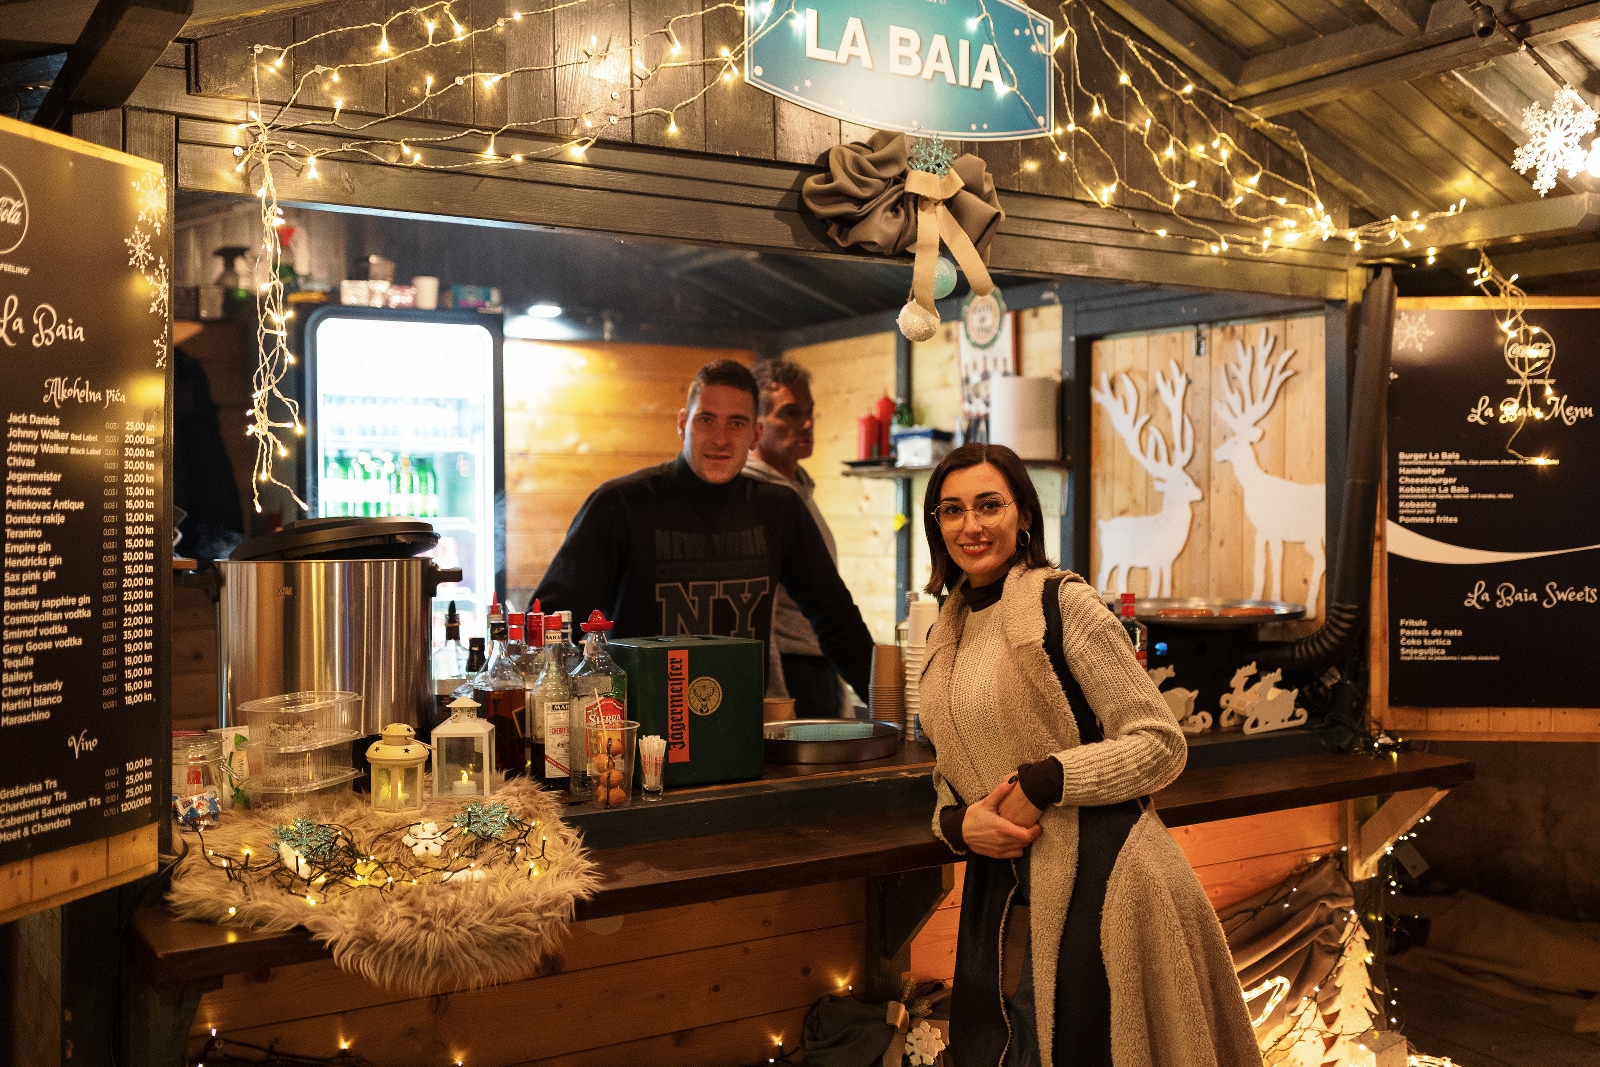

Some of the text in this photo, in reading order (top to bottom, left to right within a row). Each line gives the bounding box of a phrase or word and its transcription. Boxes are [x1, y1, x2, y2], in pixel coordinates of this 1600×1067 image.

[805, 8, 1007, 90] LA BAIA
[0, 295, 85, 348] La Baia
[43, 377, 126, 409] Alkoholna pića
[1467, 396, 1494, 425] La
[1544, 394, 1594, 426] Menu
[7, 412, 154, 432] Jack Daniels 25,00 kn
[7, 427, 38, 440] Johnny
[41, 430, 69, 440] Walker
[125, 434, 144, 445] 20,00
[146, 436, 154, 444] kn
[7, 442, 38, 454] Johnny
[40, 444, 68, 454] Walker
[124, 448, 144, 458] 30,00
[146, 448, 154, 457] kn
[1399, 452, 1460, 461] Burger La Baia
[7, 456, 154, 471] Chivas 30,00 kn
[1399, 467, 1446, 476] Hamburger
[6, 470, 154, 484] Jegermeister 20,00 kn
[1399, 476, 1457, 485] Cheeseburger
[6, 486, 154, 497] Pelinkovac 13,00 kn
[6, 500, 154, 511] Pelinkovac Antique 16,00 kn
[43, 514, 65, 525] rakije
[125, 513, 144, 523] 12,00
[146, 513, 154, 521] kn
[5, 526, 154, 538] Teranino 18,00 kn
[5, 538, 154, 554] Empire gin 15,00 kn
[5, 551, 154, 568] Hendricks gin 30,00 kn
[22, 570, 40, 582] pink
[43, 570, 56, 581] gin
[125, 565, 144, 575] 15,00
[145, 564, 153, 573] kn
[4, 577, 153, 596] Bacardi 20,00 kn
[1464, 580, 1598, 610] La Baia Sweets
[4, 590, 153, 610] Bombay sapphire gin 23,00 kn
[655, 576, 770, 637] NY
[4, 612, 62, 625] Cosmopolitan
[124, 603, 143, 614] 14,00
[145, 603, 152, 611] kn
[123, 616, 143, 627] 22,00
[145, 616, 152, 624] kn
[3, 644, 23, 654] Grey
[26, 641, 52, 652] Goose
[123, 629, 143, 640] 35,00
[145, 628, 152, 637] kn
[3, 641, 152, 669] Tequila 19,00 kn
[2, 654, 152, 683] Baileys 19,00 kn
[2, 667, 152, 697] Cherry brandy 15,00 kn
[2, 680, 152, 712] Martini bianco 16,00 kn
[667, 657, 687, 751] Jägermeister
[1, 693, 152, 726] Maraschino 18,00 kn
[68, 730, 98, 759] Vino
[126, 759, 143, 771] 10,00
[145, 758, 152, 766] kn
[0, 795, 52, 814] Chardonnay
[126, 772, 143, 785] 25,00
[145, 771, 152, 779] kn
[0, 810, 39, 828] Cabernet
[42, 801, 86, 818] Sauvignon
[126, 785, 143, 798] 25,00
[145, 784, 152, 792] kn
[23, 826, 29, 837] &
[32, 818, 70, 834] Chandon
[121, 798, 144, 812] 1200,00
